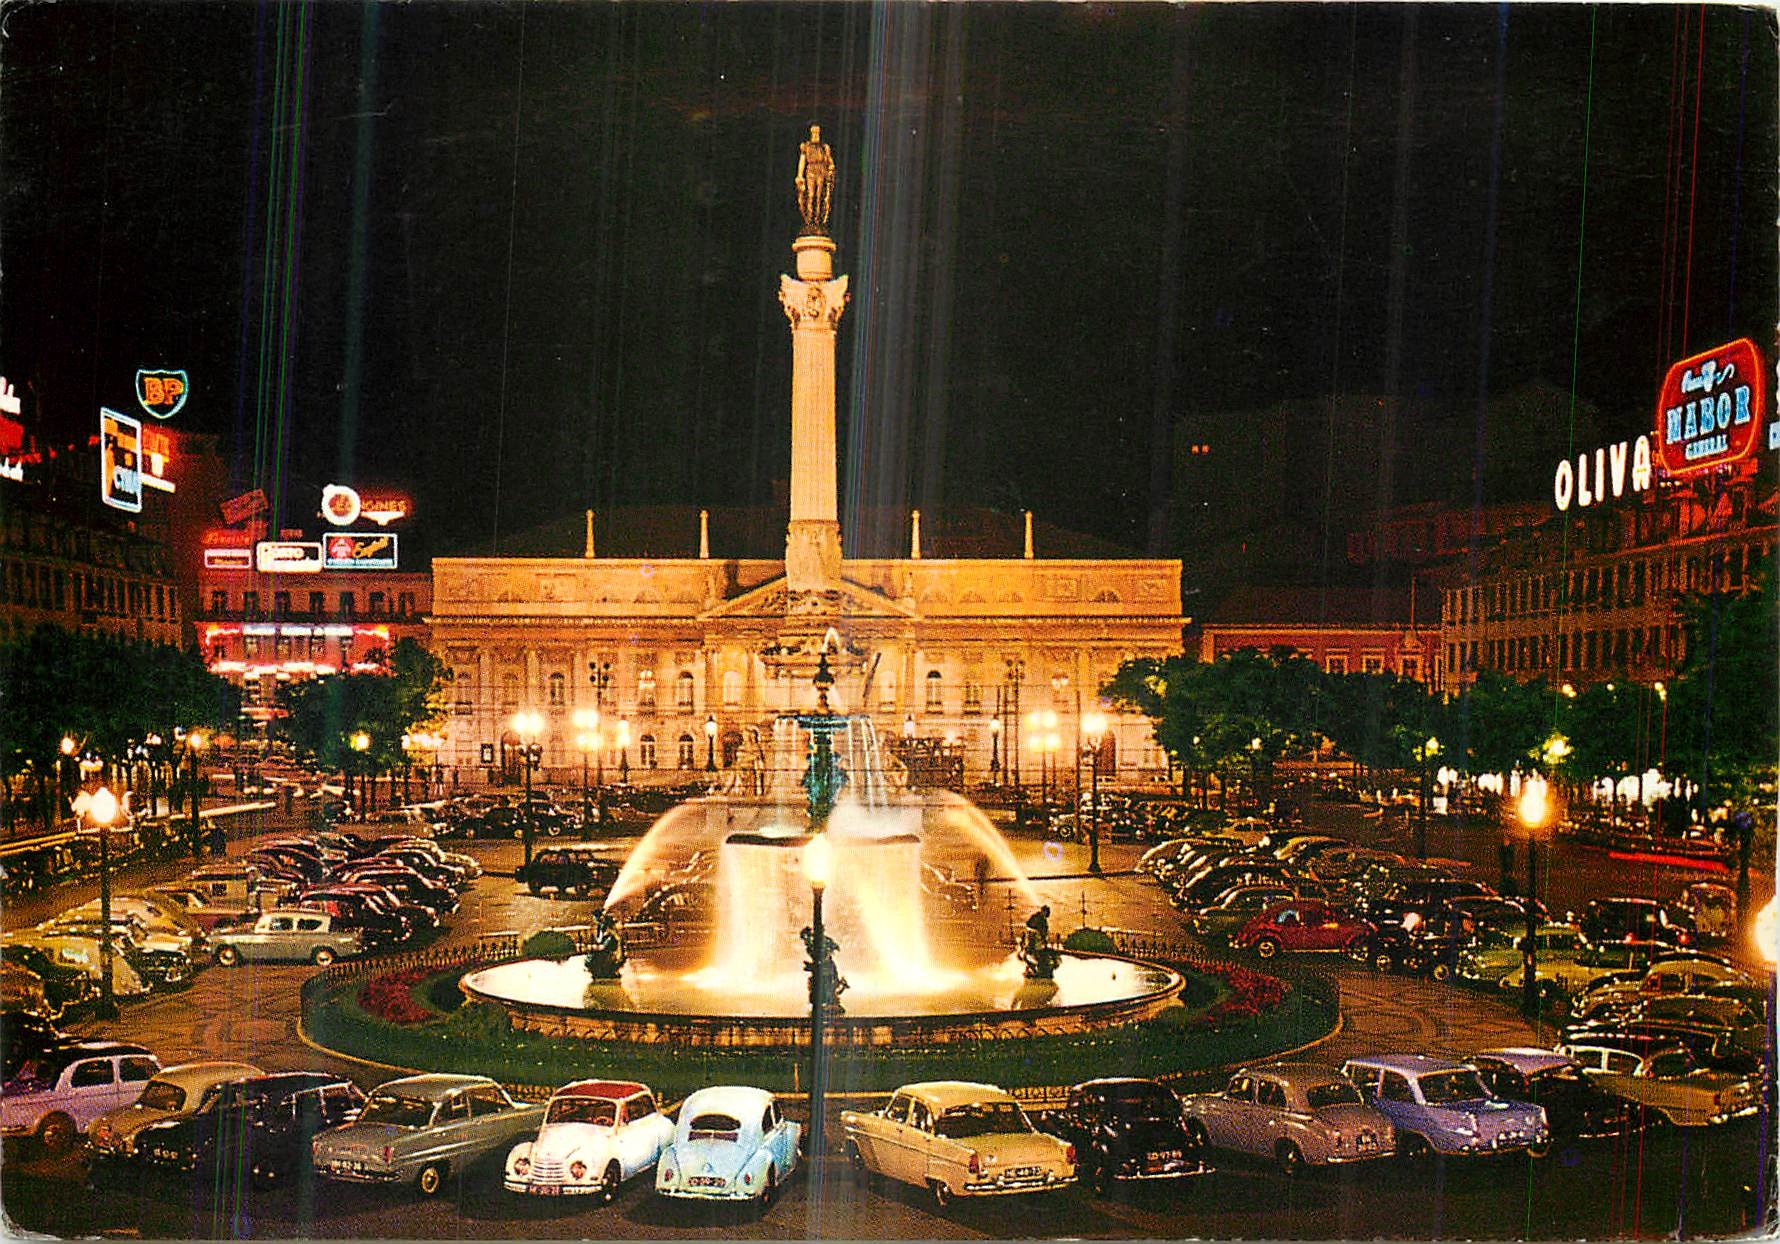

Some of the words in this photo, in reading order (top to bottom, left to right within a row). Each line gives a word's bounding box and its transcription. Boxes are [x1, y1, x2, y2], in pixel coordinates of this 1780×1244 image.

[143, 377, 184, 406] BP
[1666, 384, 1751, 445] MABOR
[1554, 434, 1651, 511] OLIVA
